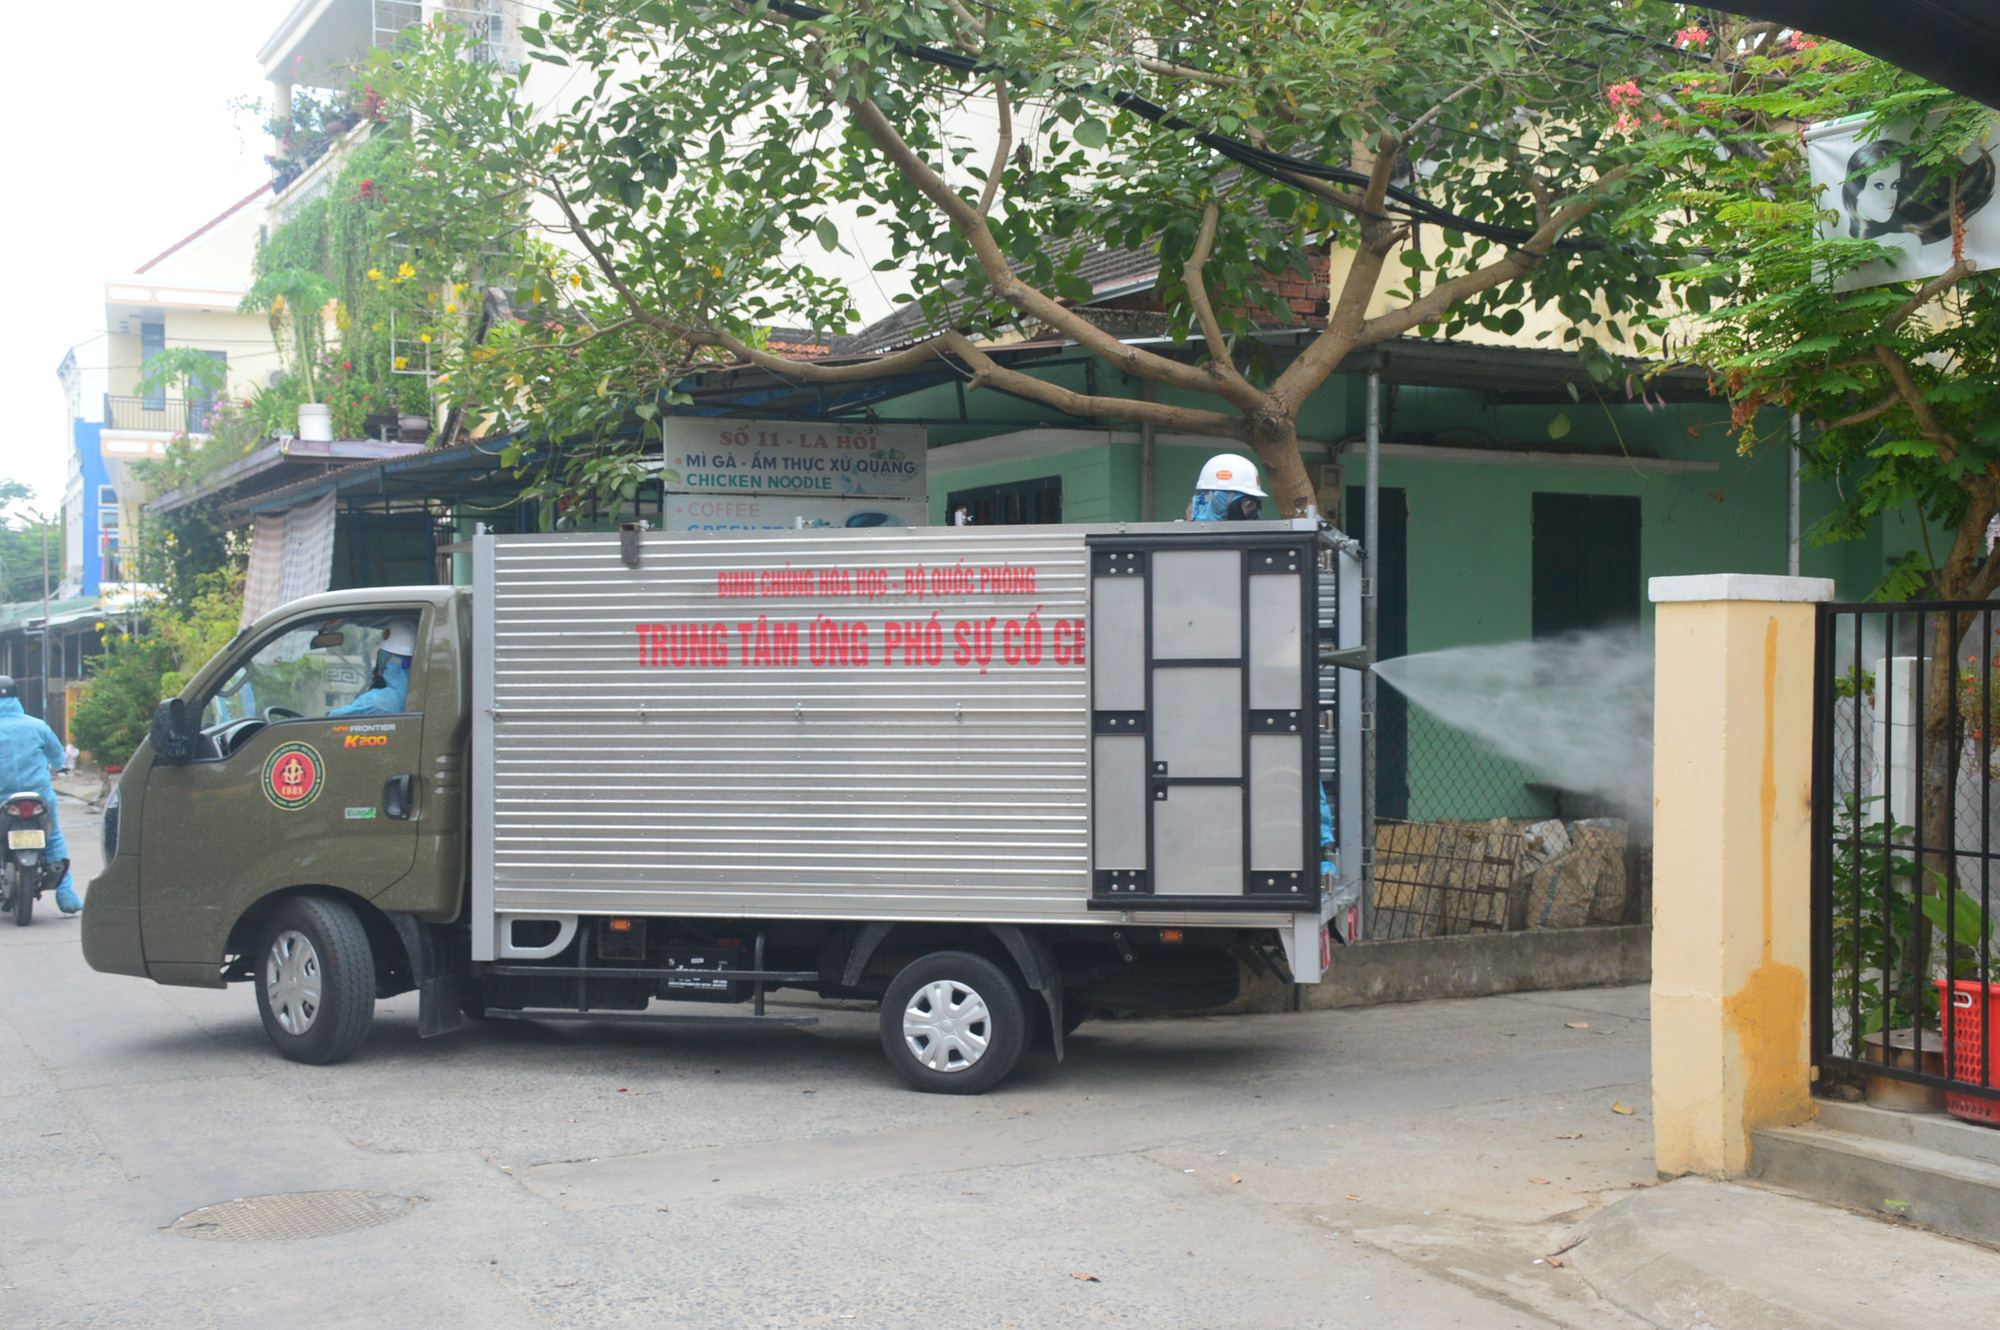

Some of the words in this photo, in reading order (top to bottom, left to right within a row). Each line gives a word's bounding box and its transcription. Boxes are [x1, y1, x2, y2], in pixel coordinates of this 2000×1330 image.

[720, 424, 750, 446] SỐ
[757, 431, 780, 447] 11
[799, 433, 829, 449] LA
[686, 451, 706, 468] MÌ
[712, 451, 737, 468] GÀ
[751, 450, 777, 470] ẨM
[782, 456, 825, 474] THỰC
[830, 455, 853, 472] XỨ
[856, 456, 916, 474] QUẢNG
[686, 473, 762, 489] CHICKEN
[768, 475, 832, 490] NOODLE
[687, 501, 760, 518] COFFEE
[718, 571, 755, 597] BINH
[761, 561, 814, 597] CHỦNG
[819, 564, 851, 596] HÓA
[856, 569, 888, 600] HỌC
[905, 563, 926, 600] BỘ
[931, 558, 975, 598] QUỐC
[980, 561, 1036, 595] PHÒNG
[635, 623, 728, 667] TRUNG
[737, 614, 799, 667] TÂM
[809, 613, 869, 667] ỨNG
[884, 611, 943, 666] PHÓ
[953, 616, 996, 675] SỰ
[1004, 604, 1043, 666] CỐ
[350, 723, 397, 733] FRONTIER
[343, 734, 388, 749] K200
